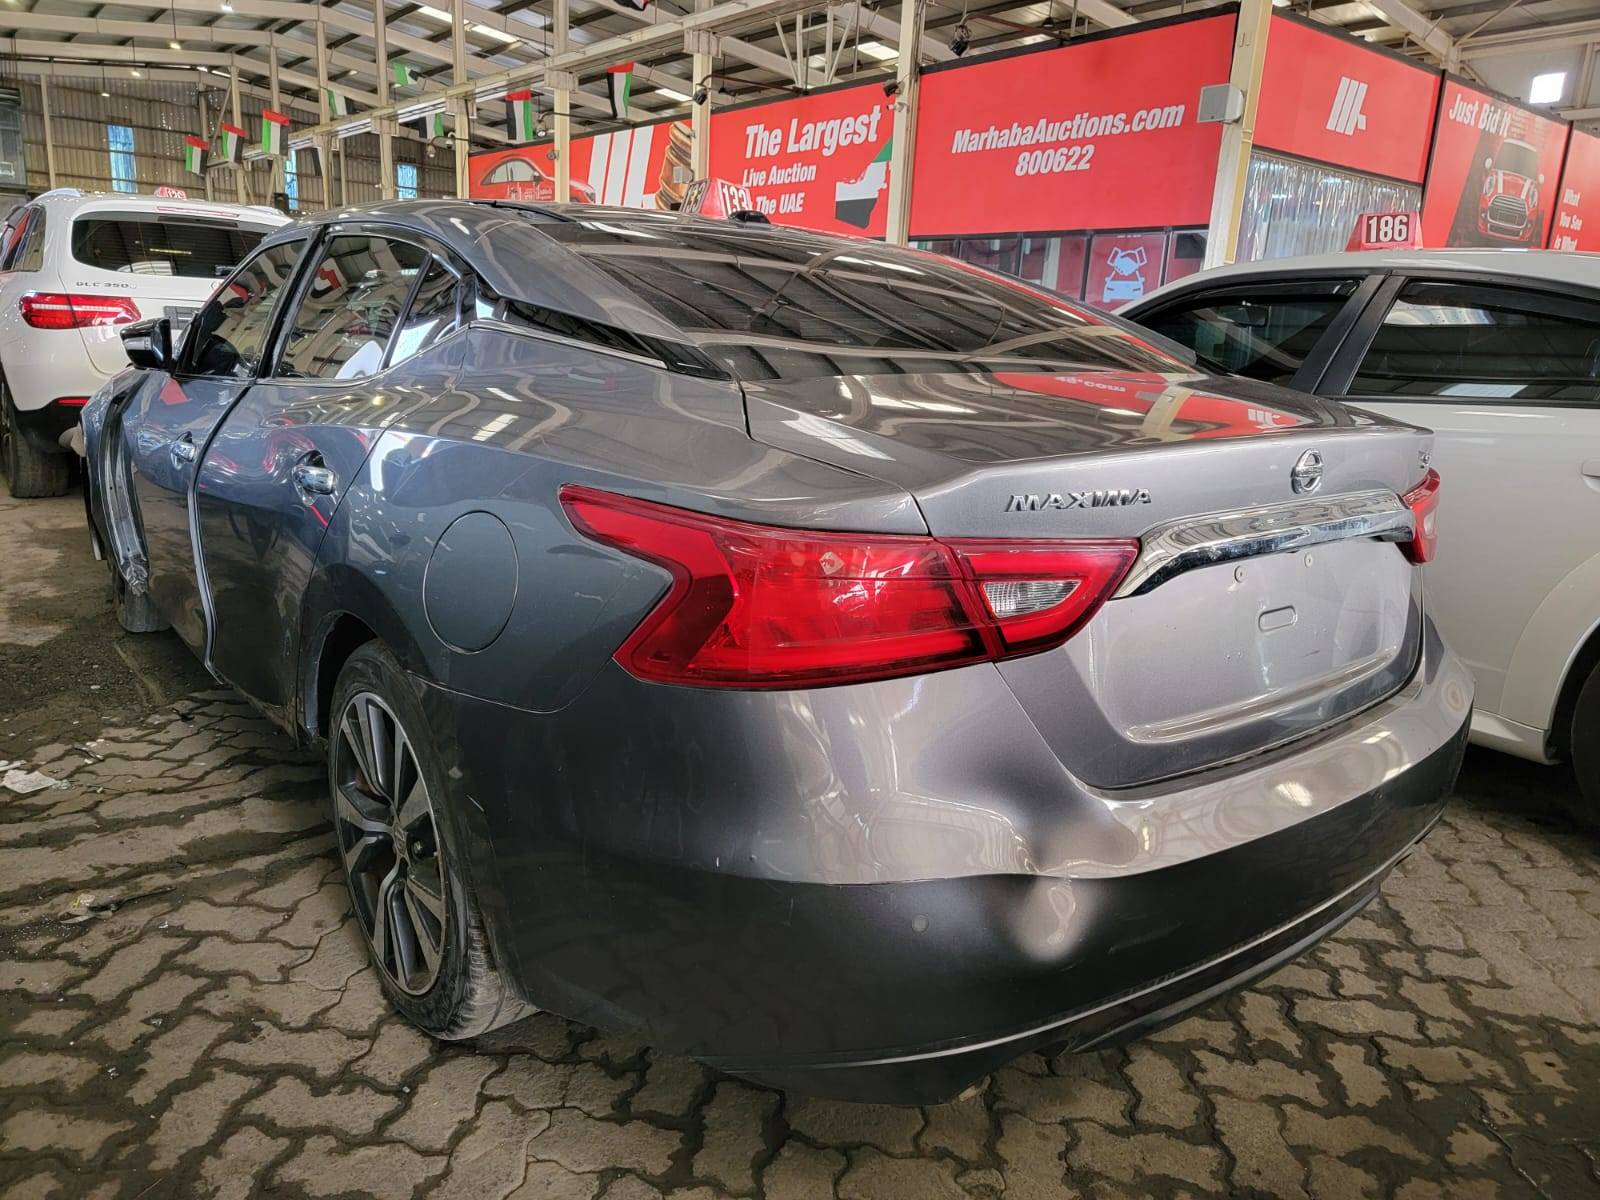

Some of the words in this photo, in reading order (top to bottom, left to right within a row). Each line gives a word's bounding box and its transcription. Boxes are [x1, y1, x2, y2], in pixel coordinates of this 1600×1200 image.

[951, 104, 1185, 153] MarhabaAuctions.com
[1449, 94, 1479, 126] Just
[1478, 103, 1501, 133] Bid
[746, 122, 782, 158] The
[787, 104, 881, 157] Largest
[743, 169, 766, 187] Live
[768, 163, 817, 185] Auction
[1015, 145, 1094, 176] 800622
[682, 182, 705, 212] 133
[723, 184, 748, 215] 133
[756, 196, 776, 215] The
[780, 192, 805, 213] UAE
[1368, 215, 1409, 242] 186
[1004, 488, 1151, 512] MAXIMA
